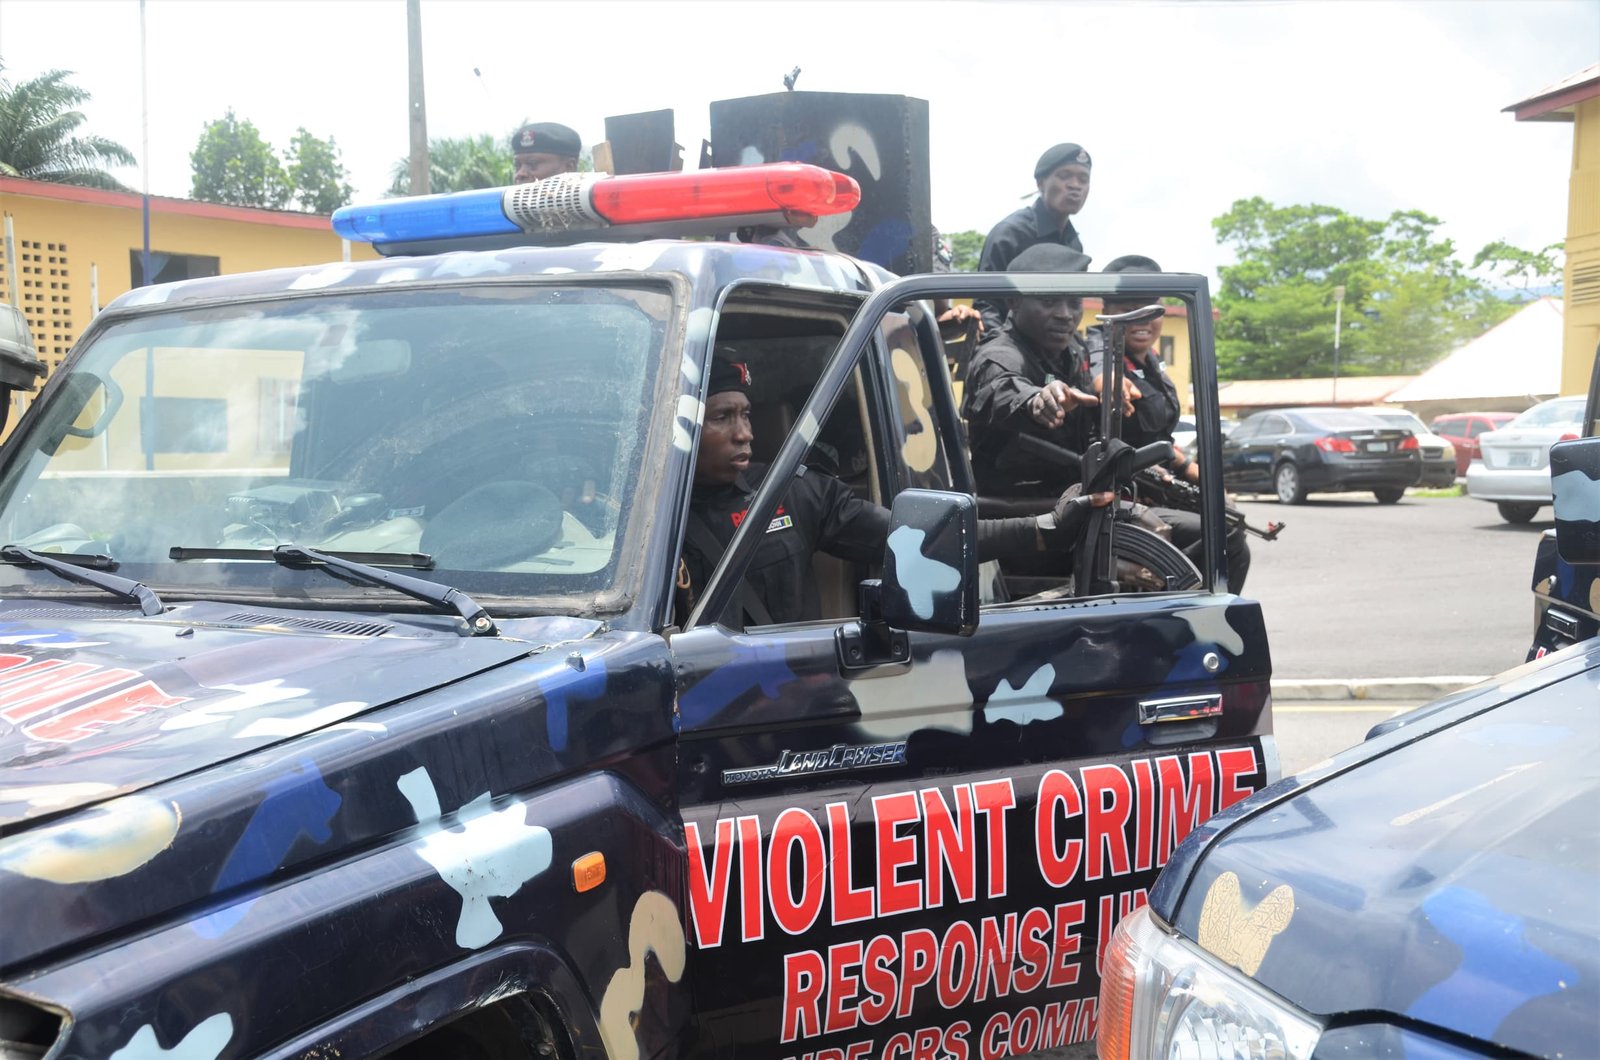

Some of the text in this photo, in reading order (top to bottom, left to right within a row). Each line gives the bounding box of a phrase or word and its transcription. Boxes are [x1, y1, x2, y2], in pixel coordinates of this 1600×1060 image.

[724, 768, 778, 784] TOYOTA
[684, 778, 1017, 950] VIOLENT
[780, 899, 1086, 1044] RESPONSE
[881, 1020, 972, 1060] CRS
